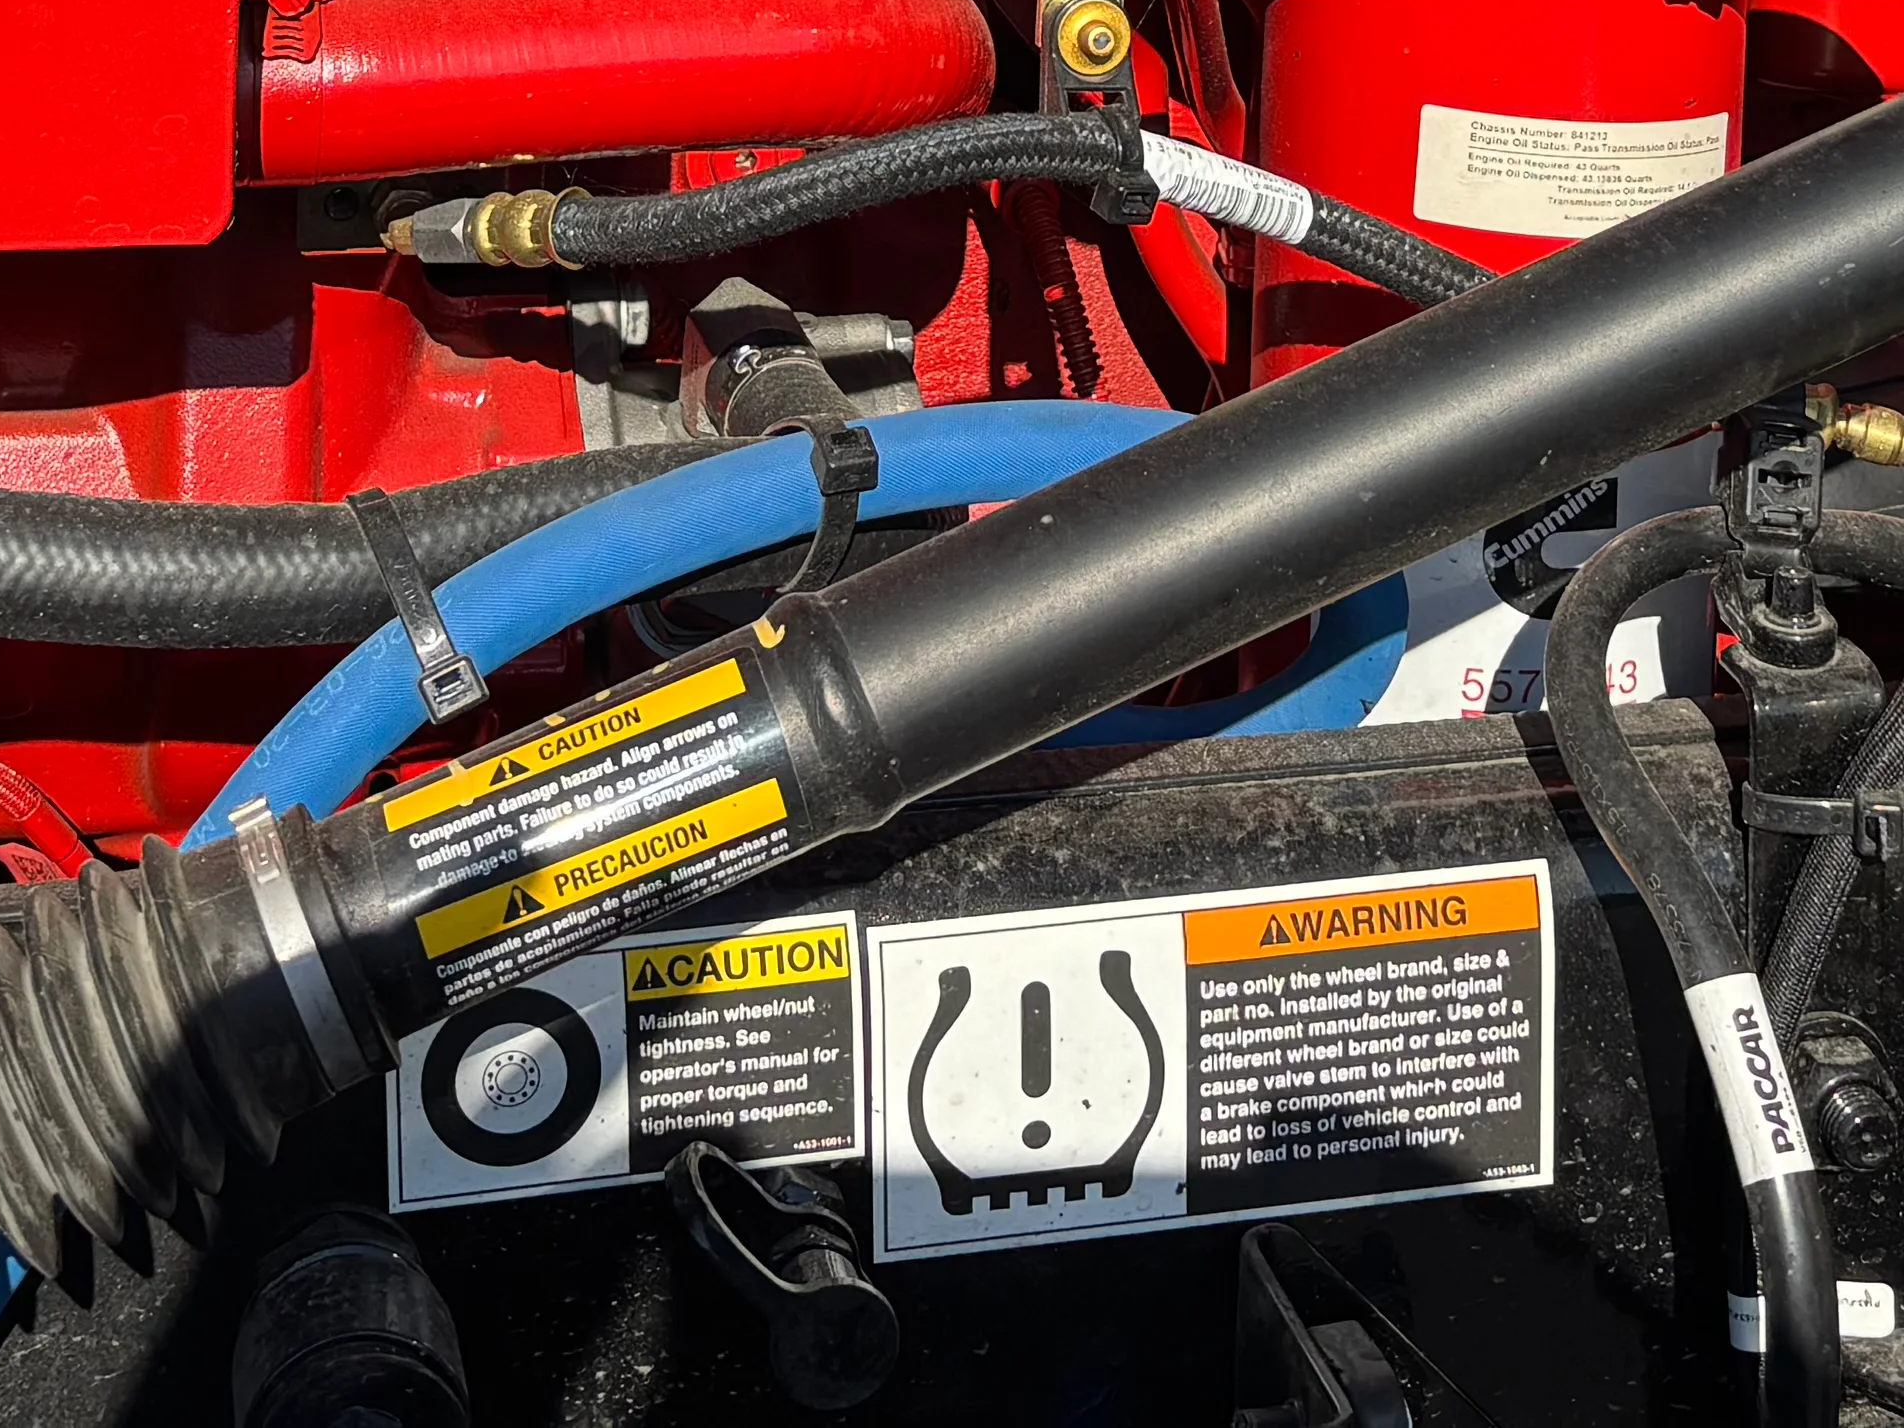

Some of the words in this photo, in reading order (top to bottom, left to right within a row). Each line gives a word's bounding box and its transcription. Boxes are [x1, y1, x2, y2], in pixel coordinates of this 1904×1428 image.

[1470, 132, 1509, 147] Engine
[1512, 137, 1529, 148] Oil
[1601, 141, 1665, 154] Transmission
[1471, 121, 1516, 135] Chassis
[1467, 164, 1503, 179] Engine
[1505, 168, 1520, 178] Oil
[1468, 152, 1503, 166] Engine
[1507, 156, 1521, 165] Oil
[1483, 479, 1608, 569] Cummins
[538, 707, 642, 762] CAUTION
[409, 802, 498, 850] Component
[498, 782, 560, 819] damage
[561, 758, 619, 795] hazard.
[620, 738, 662, 771] Align
[662, 718, 717, 753] arrows
[717, 711, 739, 735] on
[416, 836, 471, 872] mating
[472, 821, 519, 858] parts.
[519, 799, 573, 833] Failure
[574, 792, 592, 815] to
[594, 783, 615, 807] do
[615, 778, 637, 799] so
[637, 757, 680, 790] could
[437, 856, 500, 893] damage
[642, 766, 741, 818] components.
[553, 819, 709, 898] PRECAUCION
[436, 935, 521, 980] Componente
[523, 924, 550, 945] con
[552, 904, 600, 938] peligro
[602, 893, 620, 911] de
[622, 877, 668, 904] daños.
[669, 859, 718, 885] Alinear
[719, 837, 768, 864] flechas
[768, 827, 788, 844] en
[1290, 895, 1468, 945] WARNING
[443, 968, 492, 996] partes
[494, 957, 515, 973] de
[666, 937, 844, 987] CAUTION
[1200, 979, 1238, 1000] Use
[1243, 973, 1285, 997] only
[1289, 970, 1321, 990] the
[1325, 963, 1382, 986] wheel
[1387, 956, 1448, 981] brand,
[1452, 952, 1492, 973] size
[1496, 949, 1510, 967] &
[639, 1005, 719, 1032] Maintain
[723, 995, 816, 1023] wheel/nut
[1199, 1022, 1304, 1053] equipment
[1308, 1008, 1441, 1038] manufacturer.
[1447, 1002, 1484, 1021] Use
[1488, 998, 1508, 1017] of
[1511, 999, 1524, 1015] a
[1200, 1004, 1239, 1029] part
[1244, 1002, 1275, 1020] no.
[1367, 986, 1391, 1010] by
[1396, 984, 1427, 1003] the
[1431, 975, 1503, 1001] original
[639, 1031, 731, 1060] tightness.
[736, 1029, 771, 1047] See
[640, 1056, 736, 1086] operator's
[741, 1047, 809, 1072] manual
[813, 1047, 840, 1065] for
[1199, 1048, 1283, 1074] different
[1287, 1042, 1343, 1065] wheel
[1348, 1033, 1404, 1058] brand
[1409, 1033, 1430, 1050] or
[1434, 1027, 1473, 1048] size
[1477, 1019, 1530, 1043] could
[640, 1087, 703, 1113] proper
[708, 1079, 769, 1103] torque
[773, 1074, 808, 1093] and
[1199, 1077, 1259, 1098] cause
[1263, 1067, 1315, 1092] valve
[1319, 1064, 1367, 1086] stem
[1371, 1059, 1391, 1078] to
[1396, 1049, 1477, 1076] interfere
[1480, 1044, 1521, 1065] with
[1199, 1106, 1212, 1123] a
[1217, 1096, 1272, 1121] brake
[1277, 1082, 1386, 1117] component
[1390, 1077, 1447, 1102] which
[1451, 1070, 1505, 1094] could
[1733, 1004, 1796, 1155] PACCAR
[641, 1108, 734, 1136] tightening
[739, 1098, 834, 1124] sequence.
[1200, 1124, 1242, 1147] lead
[1246, 1122, 1266, 1141] to
[1272, 1117, 1311, 1137] loss
[1317, 1113, 1337, 1132] of
[1342, 1105, 1410, 1129] vehicle
[1414, 1096, 1482, 1122] control
[1485, 1092, 1522, 1113] and
[1200, 1150, 1242, 1172] may
[1246, 1144, 1287, 1164] lead
[1292, 1141, 1312, 1160] to
[1317, 1129, 1401, 1159] personal
[1405, 1125, 1465, 1150] injury.
